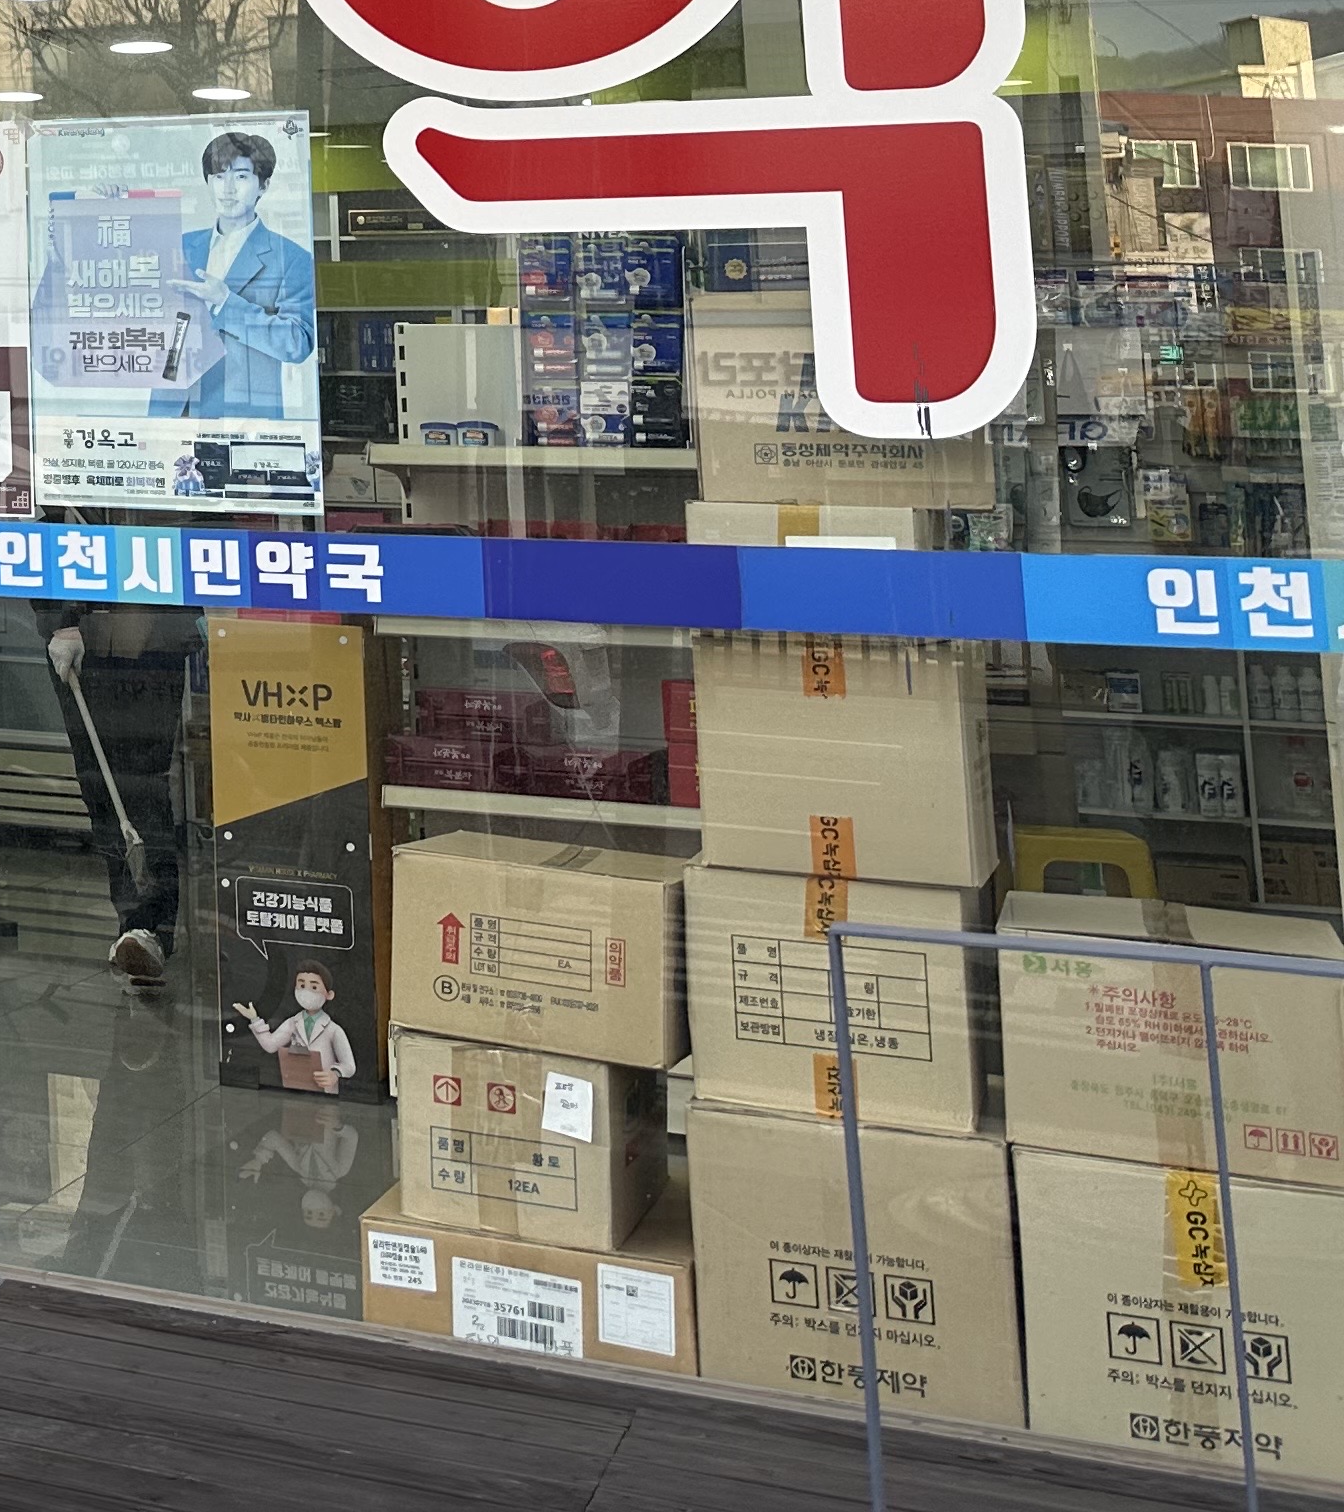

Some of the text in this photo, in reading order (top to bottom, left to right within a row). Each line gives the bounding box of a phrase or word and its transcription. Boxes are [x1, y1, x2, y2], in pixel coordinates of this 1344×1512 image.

[97, 215, 132, 248] 福
[67, 292, 164, 318] 받으세요
[69, 327, 165, 351] 귀한 회복력
[83, 354, 152, 374] 받으세요
[76, 429, 137, 449] 경옥고
[781, 443, 923, 459] 동성제약주식회사
[1146, 565, 1344, 640] 인천
[252, 891, 332, 913] 건강기능식품
[246, 910, 299, 930] 토탈케어
[558, 960, 572, 969] EA
[441, 981, 453, 995] B
[1102, 987, 1176, 1009] 주의사항
[738, 995, 779, 1010] 제조번호
[740, 1020, 780, 1036] 보관방법
[508, 1179, 540, 1194] 12EA
[1186, 1211, 1209, 1241] GC
[782, 1242, 831, 1259] 종이상자는
[876, 1254, 930, 1273] 가능합니다.
[494, 1301, 525, 1316] 35761
[1121, 1294, 1174, 1312] 종이상자는
[1178, 1302, 1221, 1319] 재활용이
[769, 1312, 941, 1349] 주의: 박스를 마십시오.
[1107, 1369, 1232, 1398] 주의: 박스를 던지지
